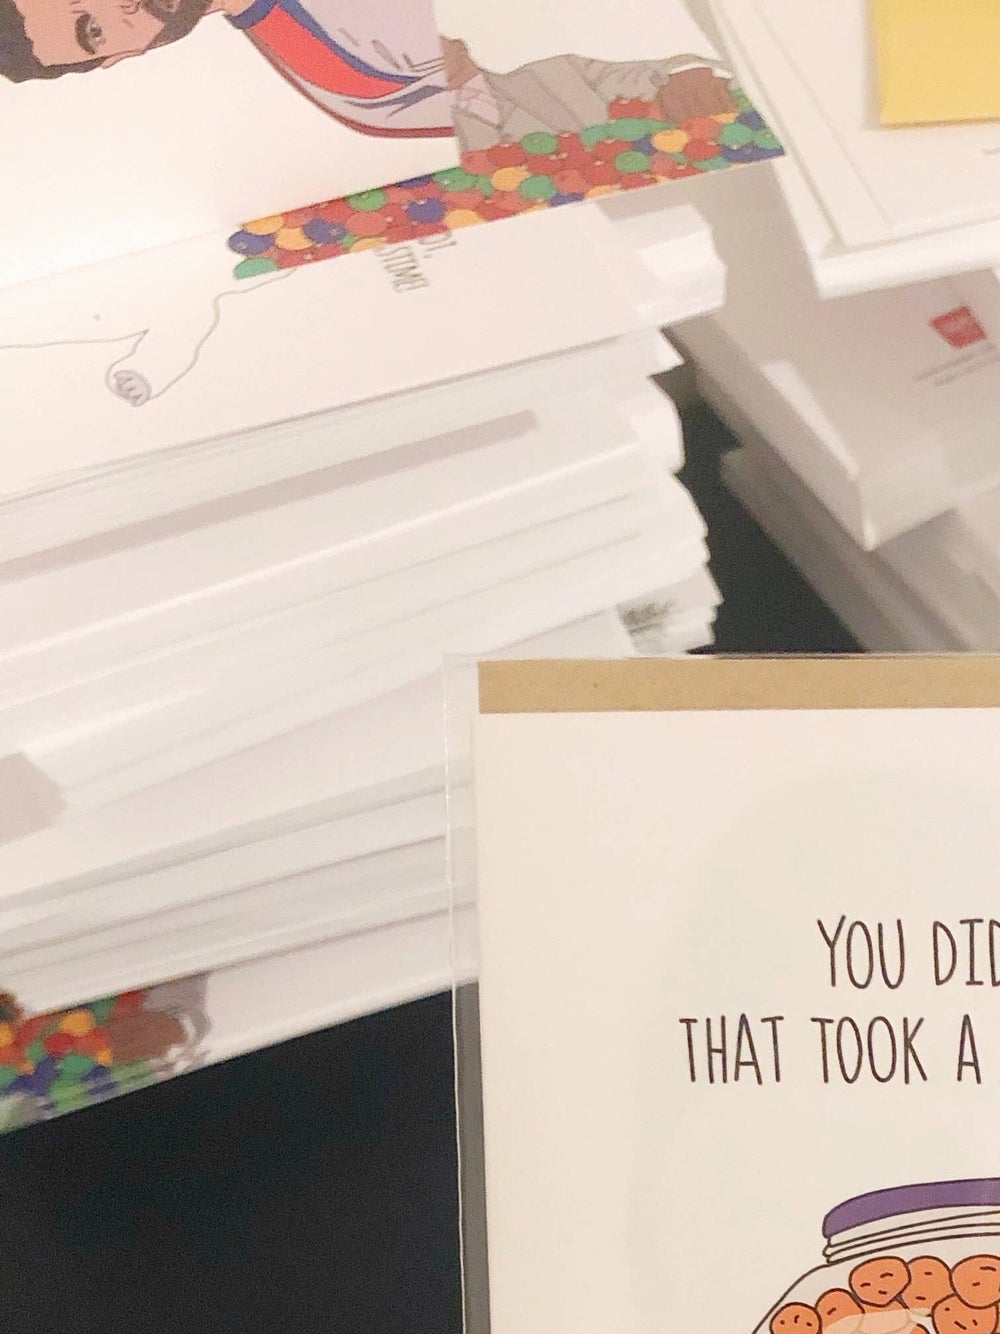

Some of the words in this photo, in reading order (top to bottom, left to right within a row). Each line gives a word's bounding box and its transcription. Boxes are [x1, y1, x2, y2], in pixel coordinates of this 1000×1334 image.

[816, 914, 905, 990] YOU
[678, 1012, 785, 1086] THAT
[810, 1015, 928, 1085] TOOK
[956, 1013, 982, 1085] A
